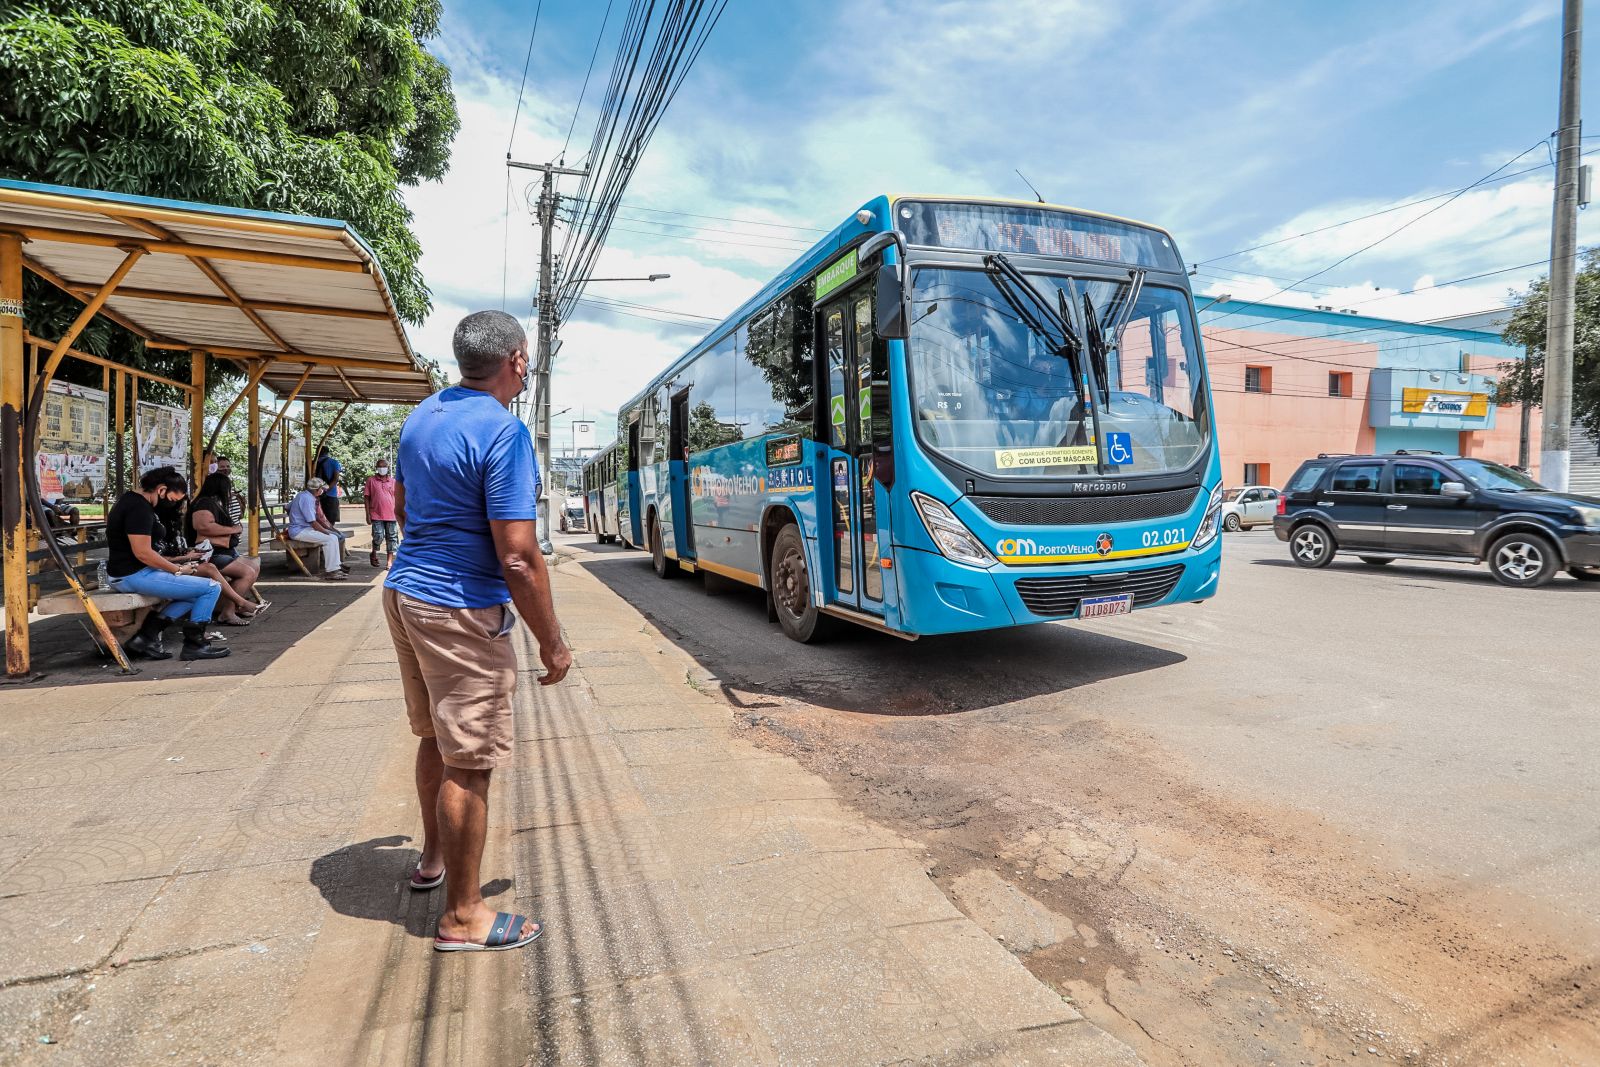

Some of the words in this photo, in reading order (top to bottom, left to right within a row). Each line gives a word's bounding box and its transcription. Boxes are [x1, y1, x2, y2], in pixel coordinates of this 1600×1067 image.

[817, 255, 855, 289] EMBARQUE
[937, 401, 949, 409] R$
[1019, 457, 1036, 465] COM
[1036, 456, 1051, 464] USO
[1062, 455, 1095, 463] MÁSCARA
[1072, 482, 1127, 492] Marcopolo
[1142, 528, 1186, 547] 02.021
